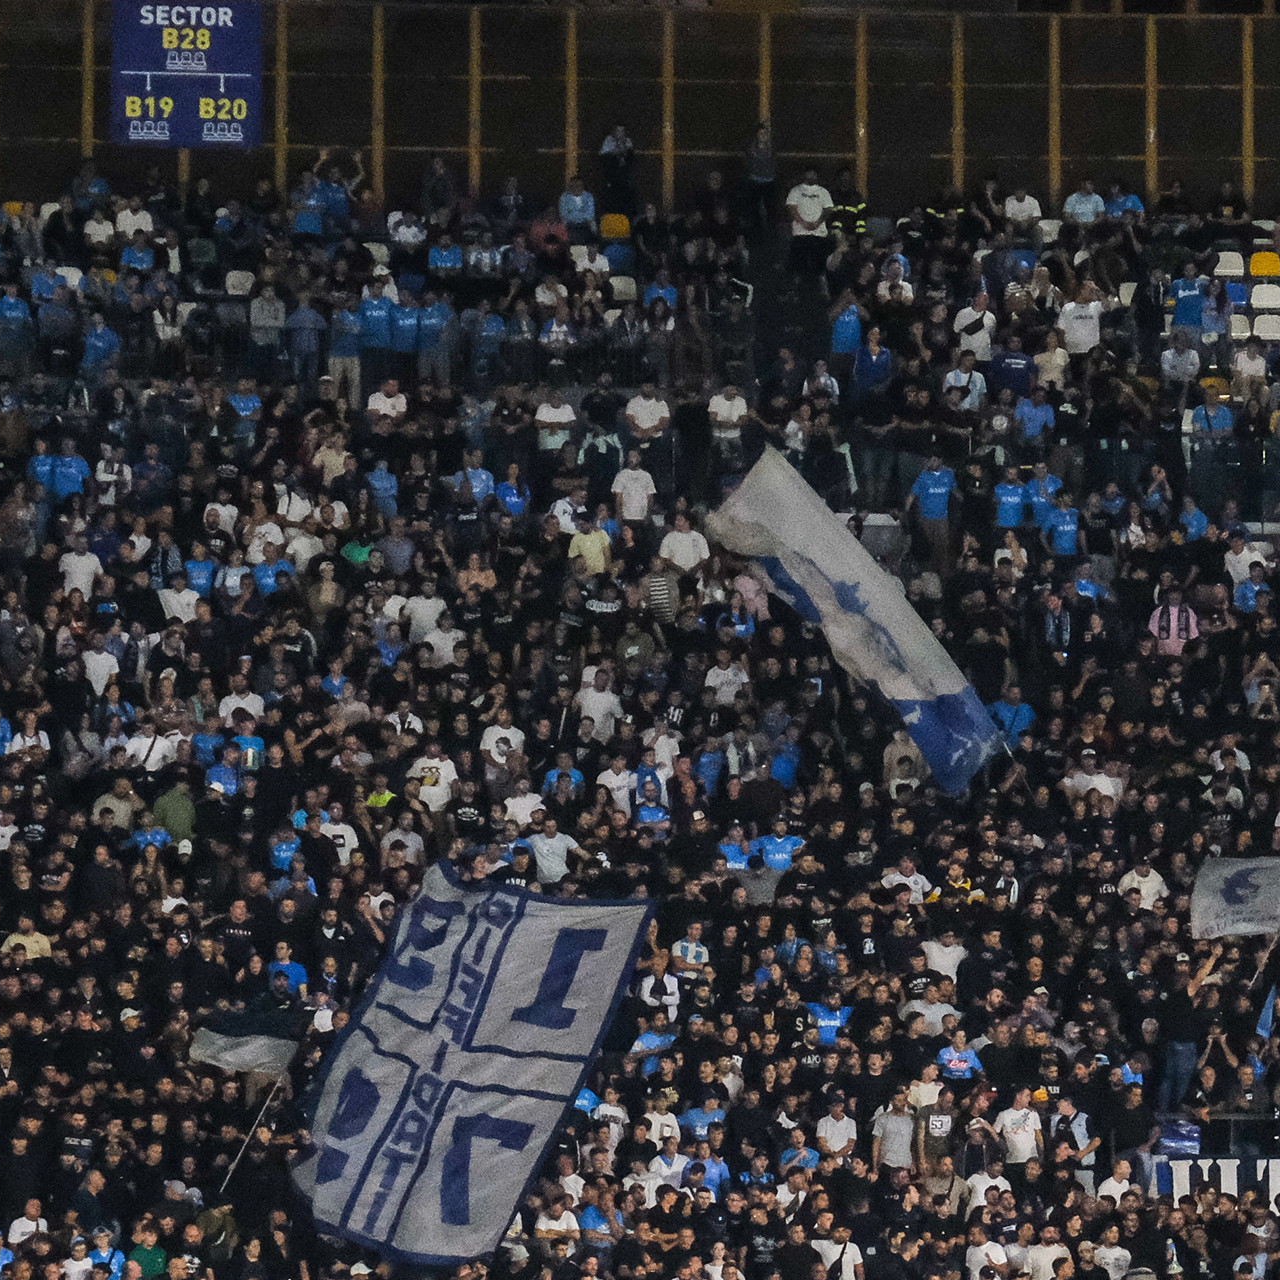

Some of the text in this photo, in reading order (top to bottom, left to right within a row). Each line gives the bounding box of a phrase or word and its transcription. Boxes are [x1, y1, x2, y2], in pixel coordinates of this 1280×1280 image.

[140, 5, 233, 27] SECTOR
[162, 28, 211, 50] B28
[125, 96, 247, 120] B19 B20
